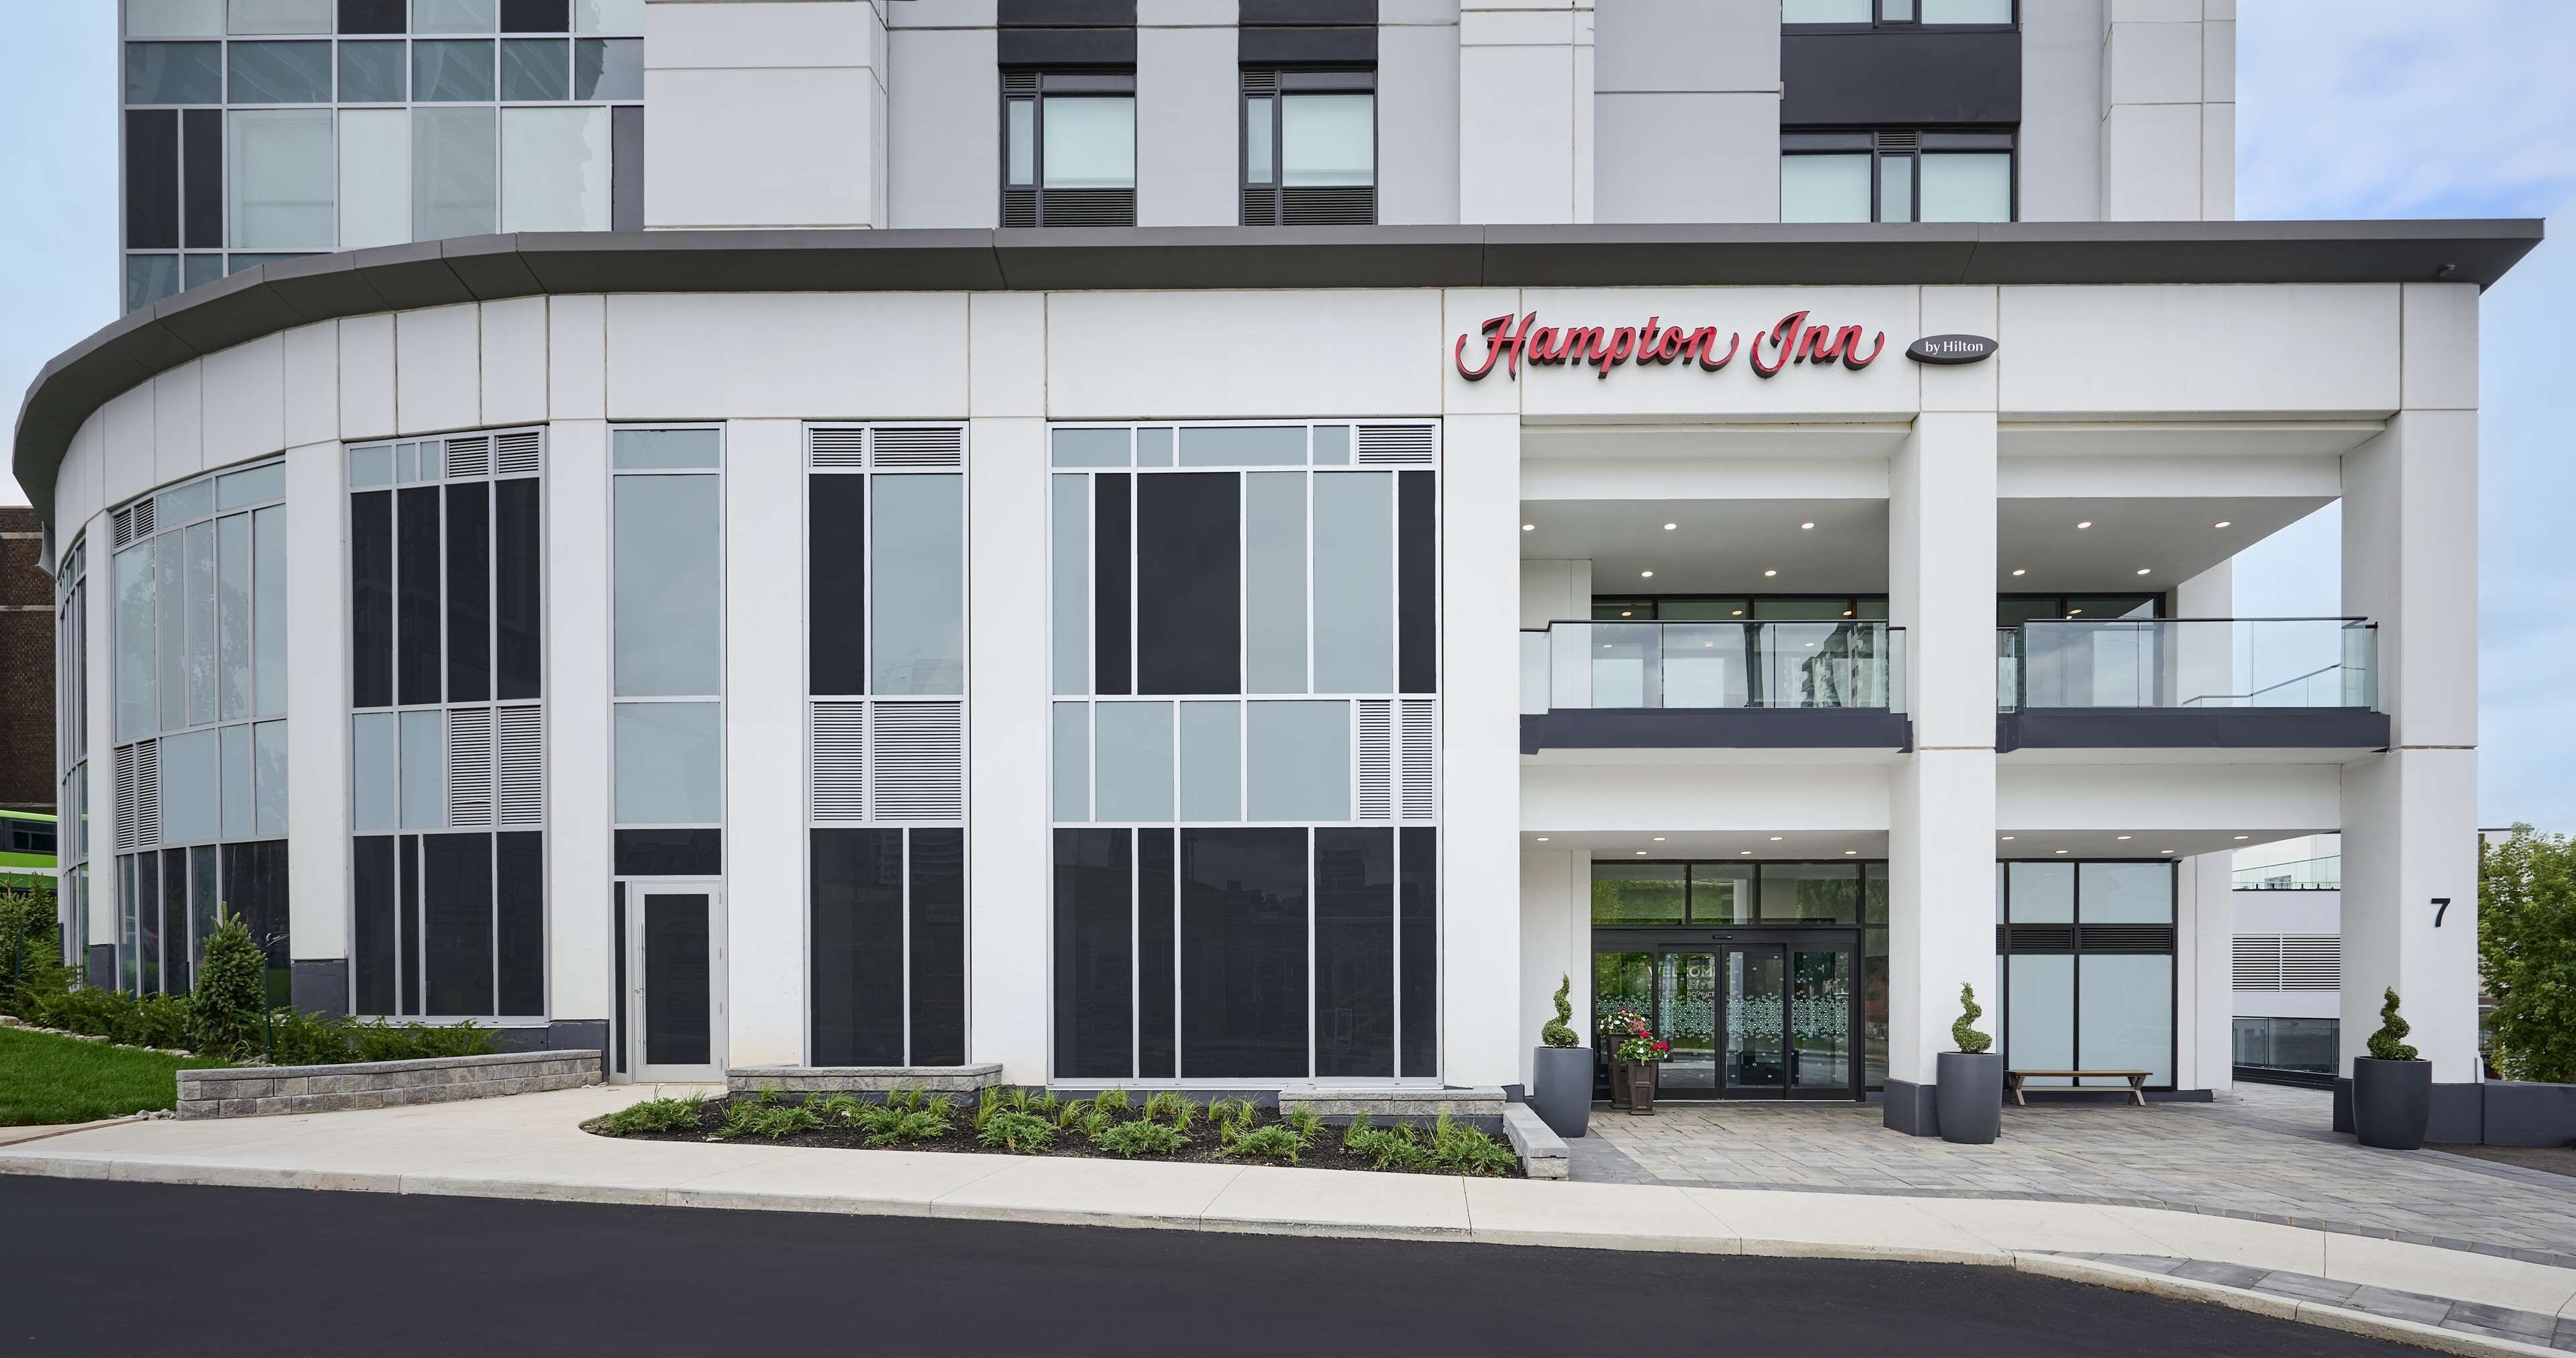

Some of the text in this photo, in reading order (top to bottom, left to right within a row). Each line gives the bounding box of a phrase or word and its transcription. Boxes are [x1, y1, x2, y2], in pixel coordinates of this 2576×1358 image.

[1455, 311, 1885, 381] Hampton Inn
[1925, 341, 1984, 355] by Hilton
[2431, 898, 2451, 927] 7
